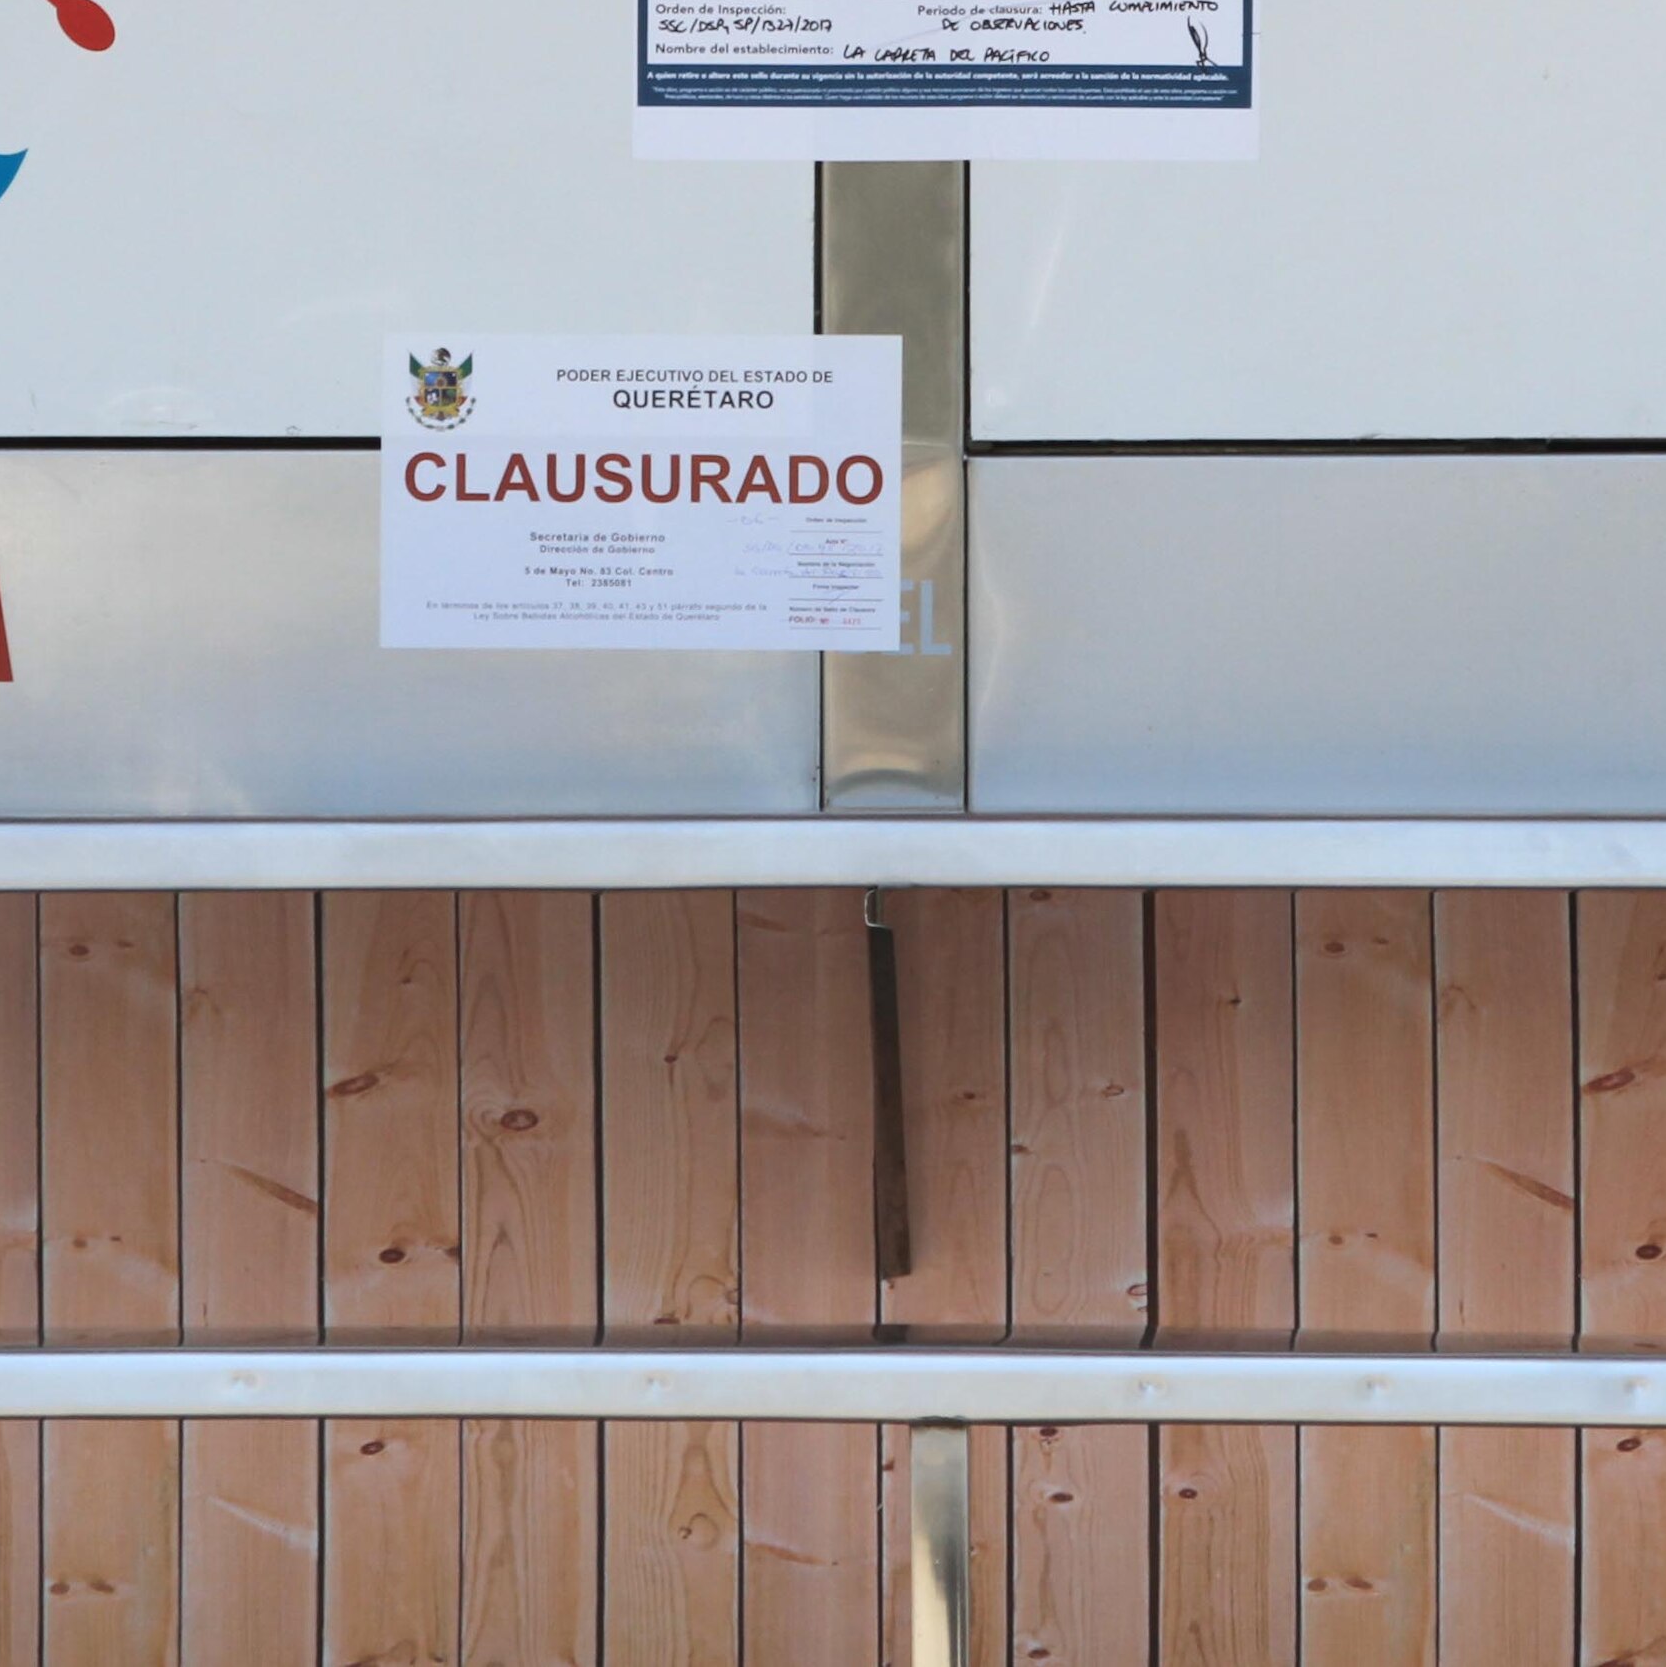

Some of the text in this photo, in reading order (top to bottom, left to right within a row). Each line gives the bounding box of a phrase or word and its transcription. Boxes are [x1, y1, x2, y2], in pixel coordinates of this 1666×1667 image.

[655, 4, 785, 17] Orden de Inspección:
[918, 5, 1042, 16] Periodo de clausura:
[656, 43, 833, 54] Nombre del establecimiento:
[557, 369, 833, 383] PODER EJECUTIVO DEL ESTADO DE
[613, 386, 773, 409] QUERÉTARO
[405, 453, 883, 504] CLAUSURADO
[530, 532, 665, 542] Secretaria de Gobierno
[539, 545, 589, 553] Dirección
[608, 545, 655, 553] Gobierno
